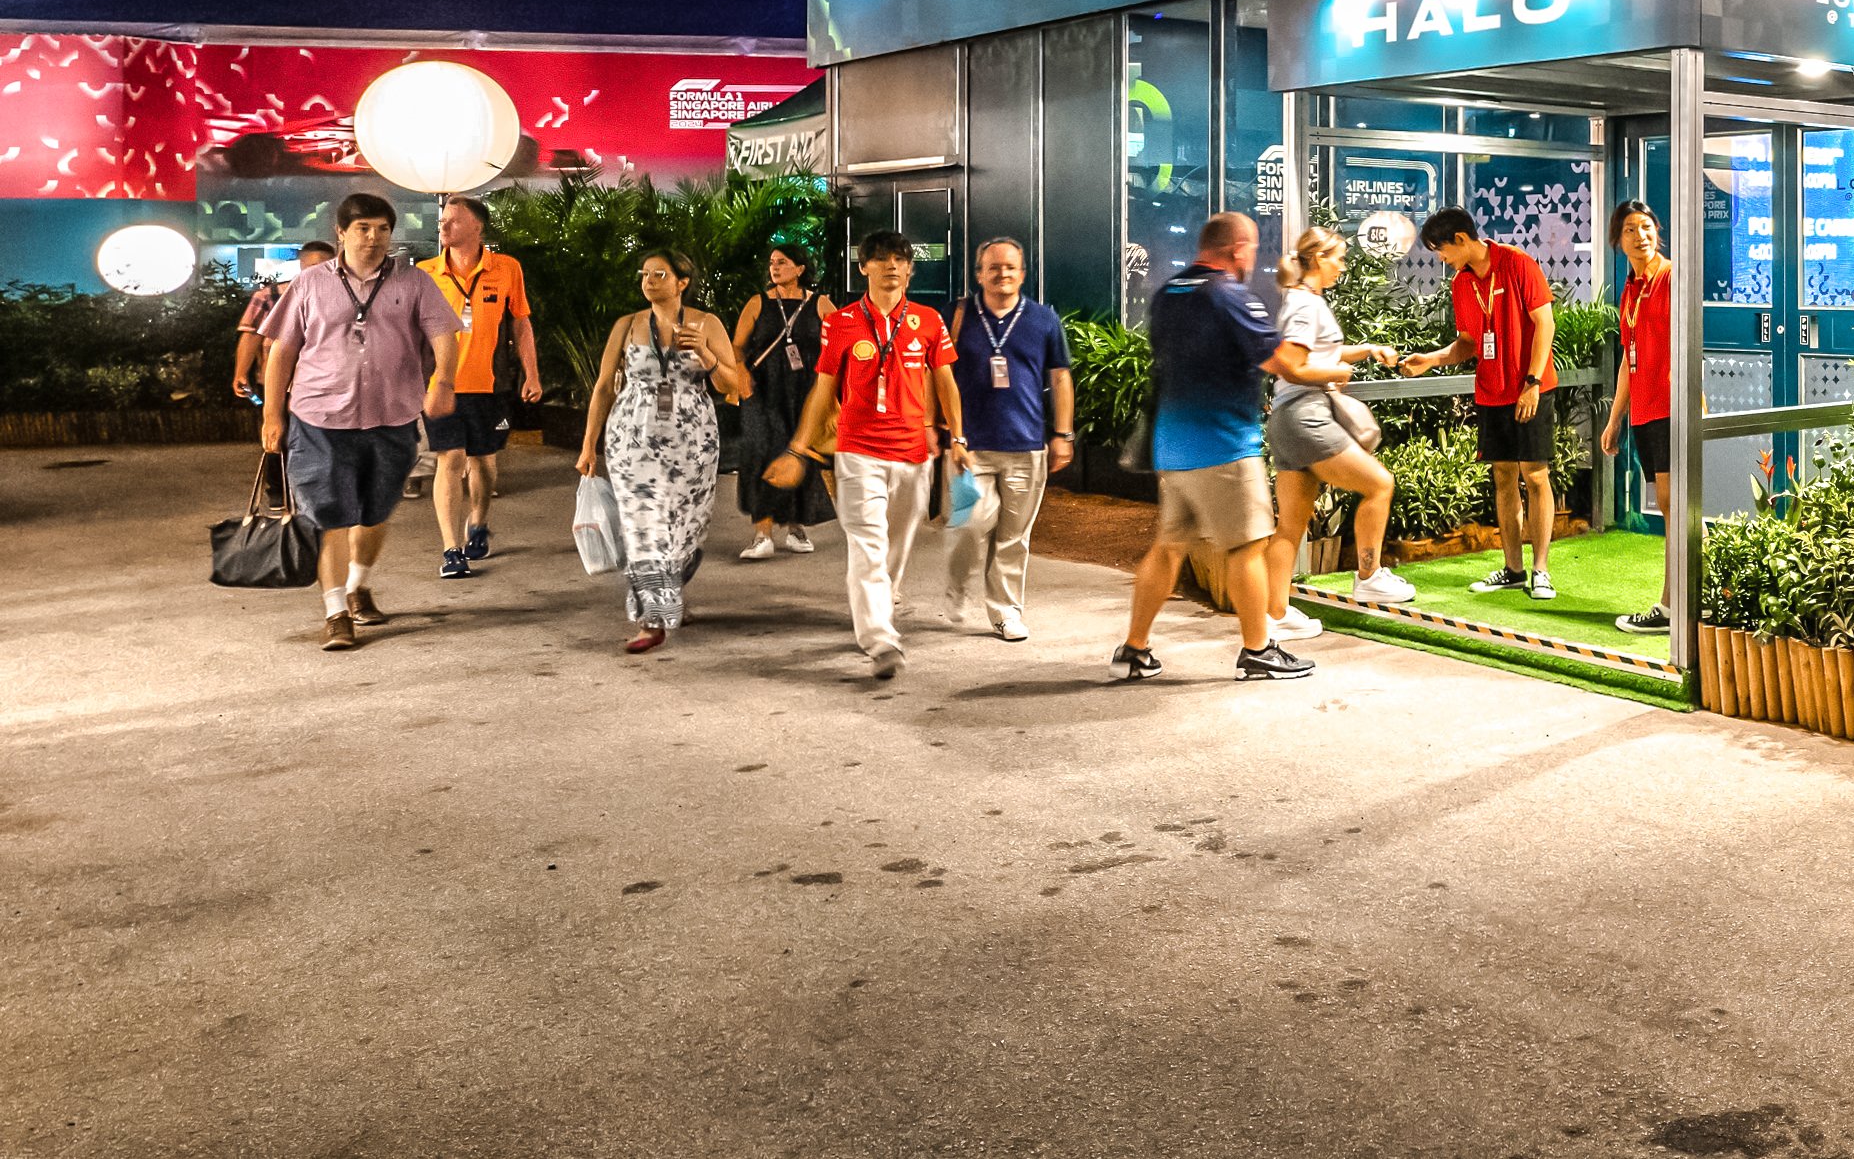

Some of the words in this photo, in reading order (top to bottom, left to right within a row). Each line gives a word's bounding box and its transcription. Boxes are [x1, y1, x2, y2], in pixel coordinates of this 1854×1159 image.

[670, 91, 734, 101] FORMULA
[736, 91, 744, 101] 1
[670, 101, 745, 110] SINGAPORE
[670, 110, 745, 120] SINGAPORE
[738, 136, 785, 167] FIRST
[1708, 210, 1729, 220] PRIX
